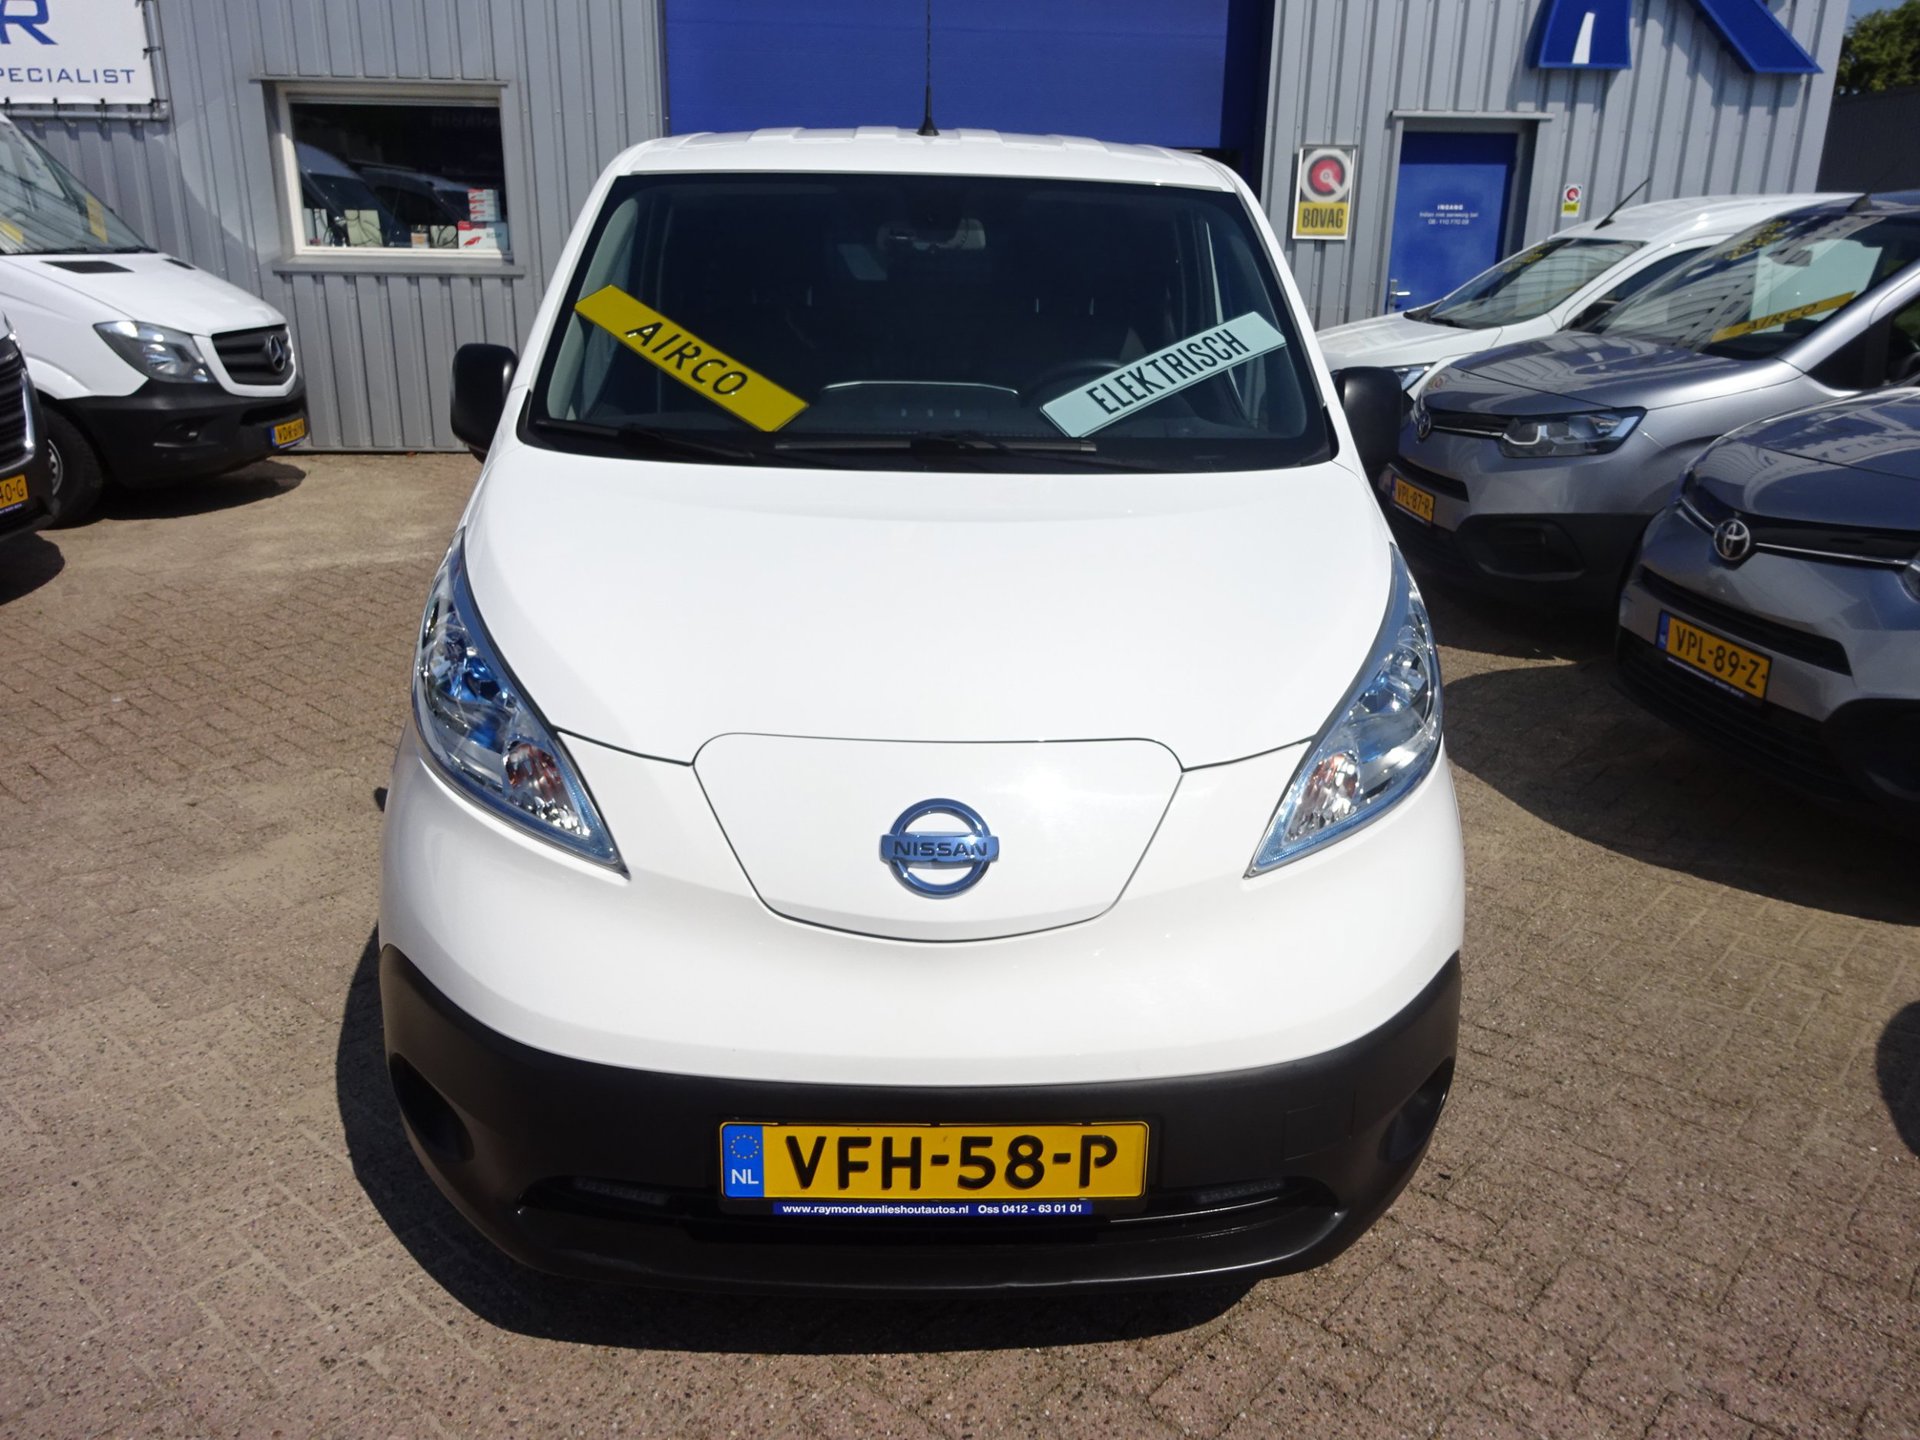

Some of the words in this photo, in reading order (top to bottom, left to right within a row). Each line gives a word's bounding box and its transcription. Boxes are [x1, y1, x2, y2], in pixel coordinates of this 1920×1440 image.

[1302, 207, 1344, 229] BOVAG
[625, 321, 748, 396] AIRCO
[1086, 328, 1250, 415] ELEKTRISCH
[1676, 625, 1760, 689] VPL-89-Z
[894, 841, 987, 856] NISSAN
[731, 1169, 759, 1185] NL
[785, 1134, 1118, 1191] VFH-58-P
[782, 1204, 969, 1215] www.raymondvanlieshoutautos.nl
[978, 1204, 999, 1213] Oss
[1002, 1204, 1028, 1213] 0412
[1038, 1204, 1051, 1213] 63
[1054, 1204, 1067, 1213] 01
[1070, 1204, 1083, 1213] 01
